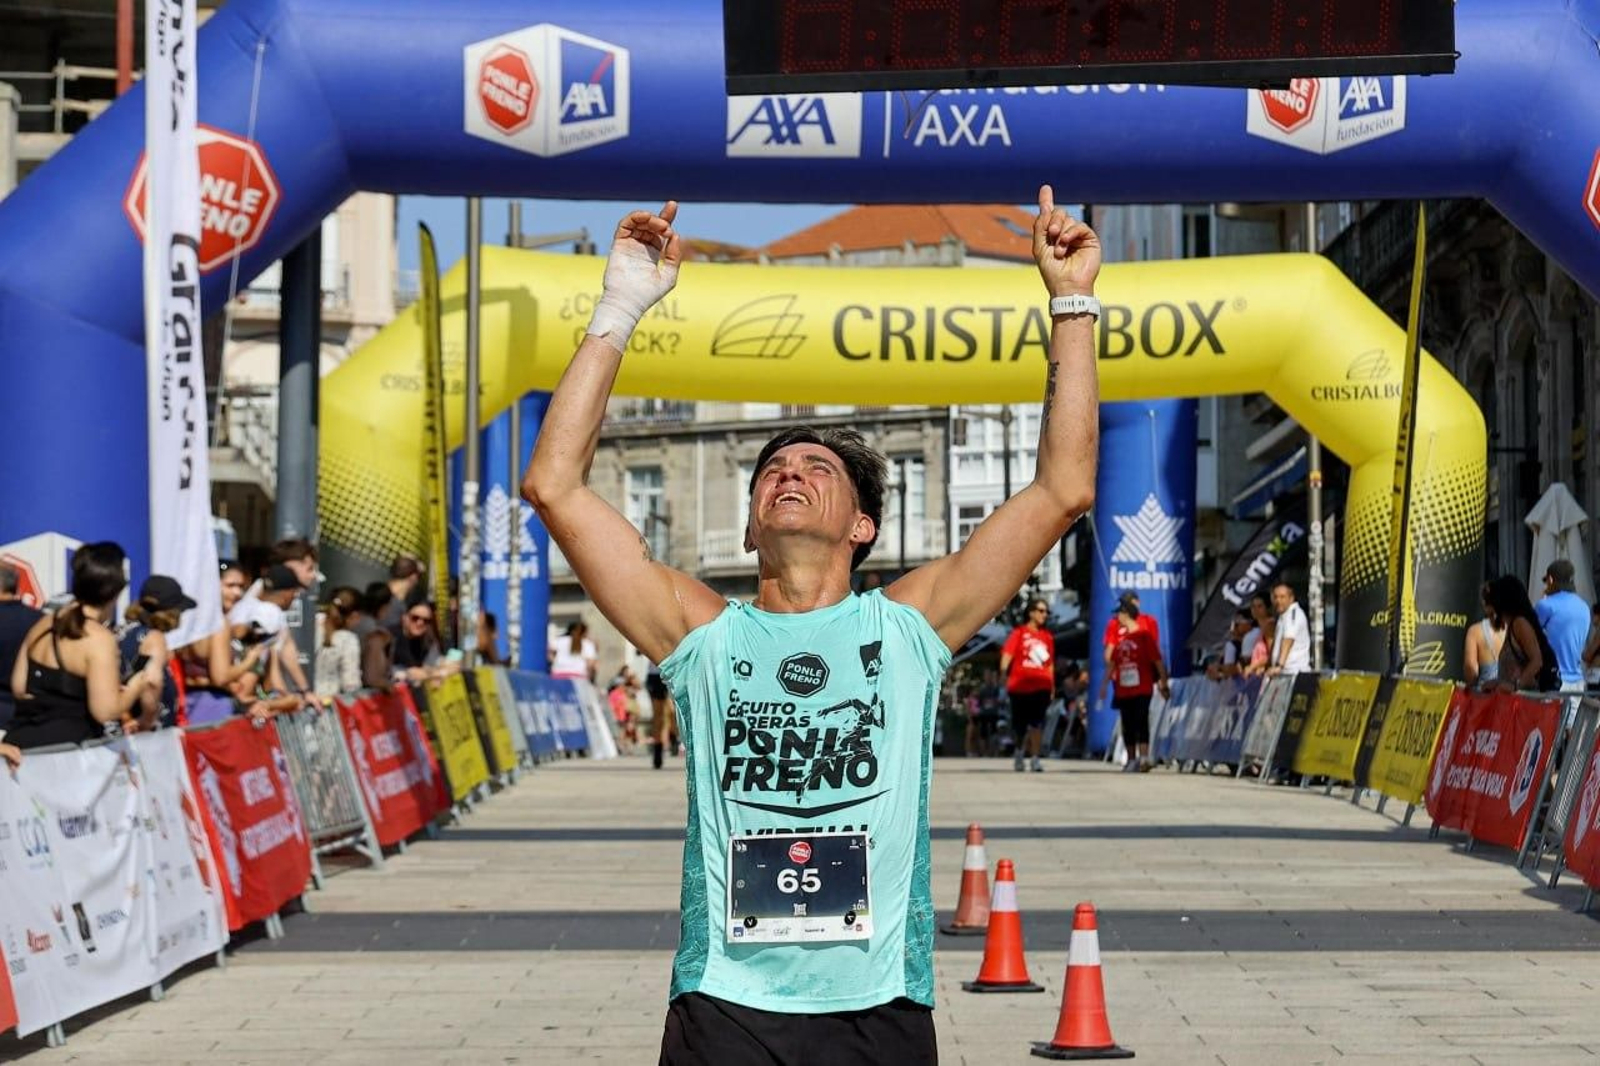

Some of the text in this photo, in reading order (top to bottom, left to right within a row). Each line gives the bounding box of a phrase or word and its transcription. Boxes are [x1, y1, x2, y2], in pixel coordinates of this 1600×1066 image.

[560, 82, 609, 120] AXA
[1340, 76, 1386, 113] AXA
[727, 97, 836, 145] AXA
[913, 104, 1012, 147] AXA
[200, 173, 264, 214] NLE
[573, 326, 681, 355] CCK?
[833, 299, 1226, 363] CRISTABOX
[1311, 383, 1402, 401] CRISTALB
[1109, 566, 1187, 590] luanvi
[783, 671, 821, 686] FRENO
[786, 662, 824, 678] PONLE
[723, 719, 873, 760] PONLE
[721, 755, 878, 793] FRENO
[776, 868, 822, 894] 65
